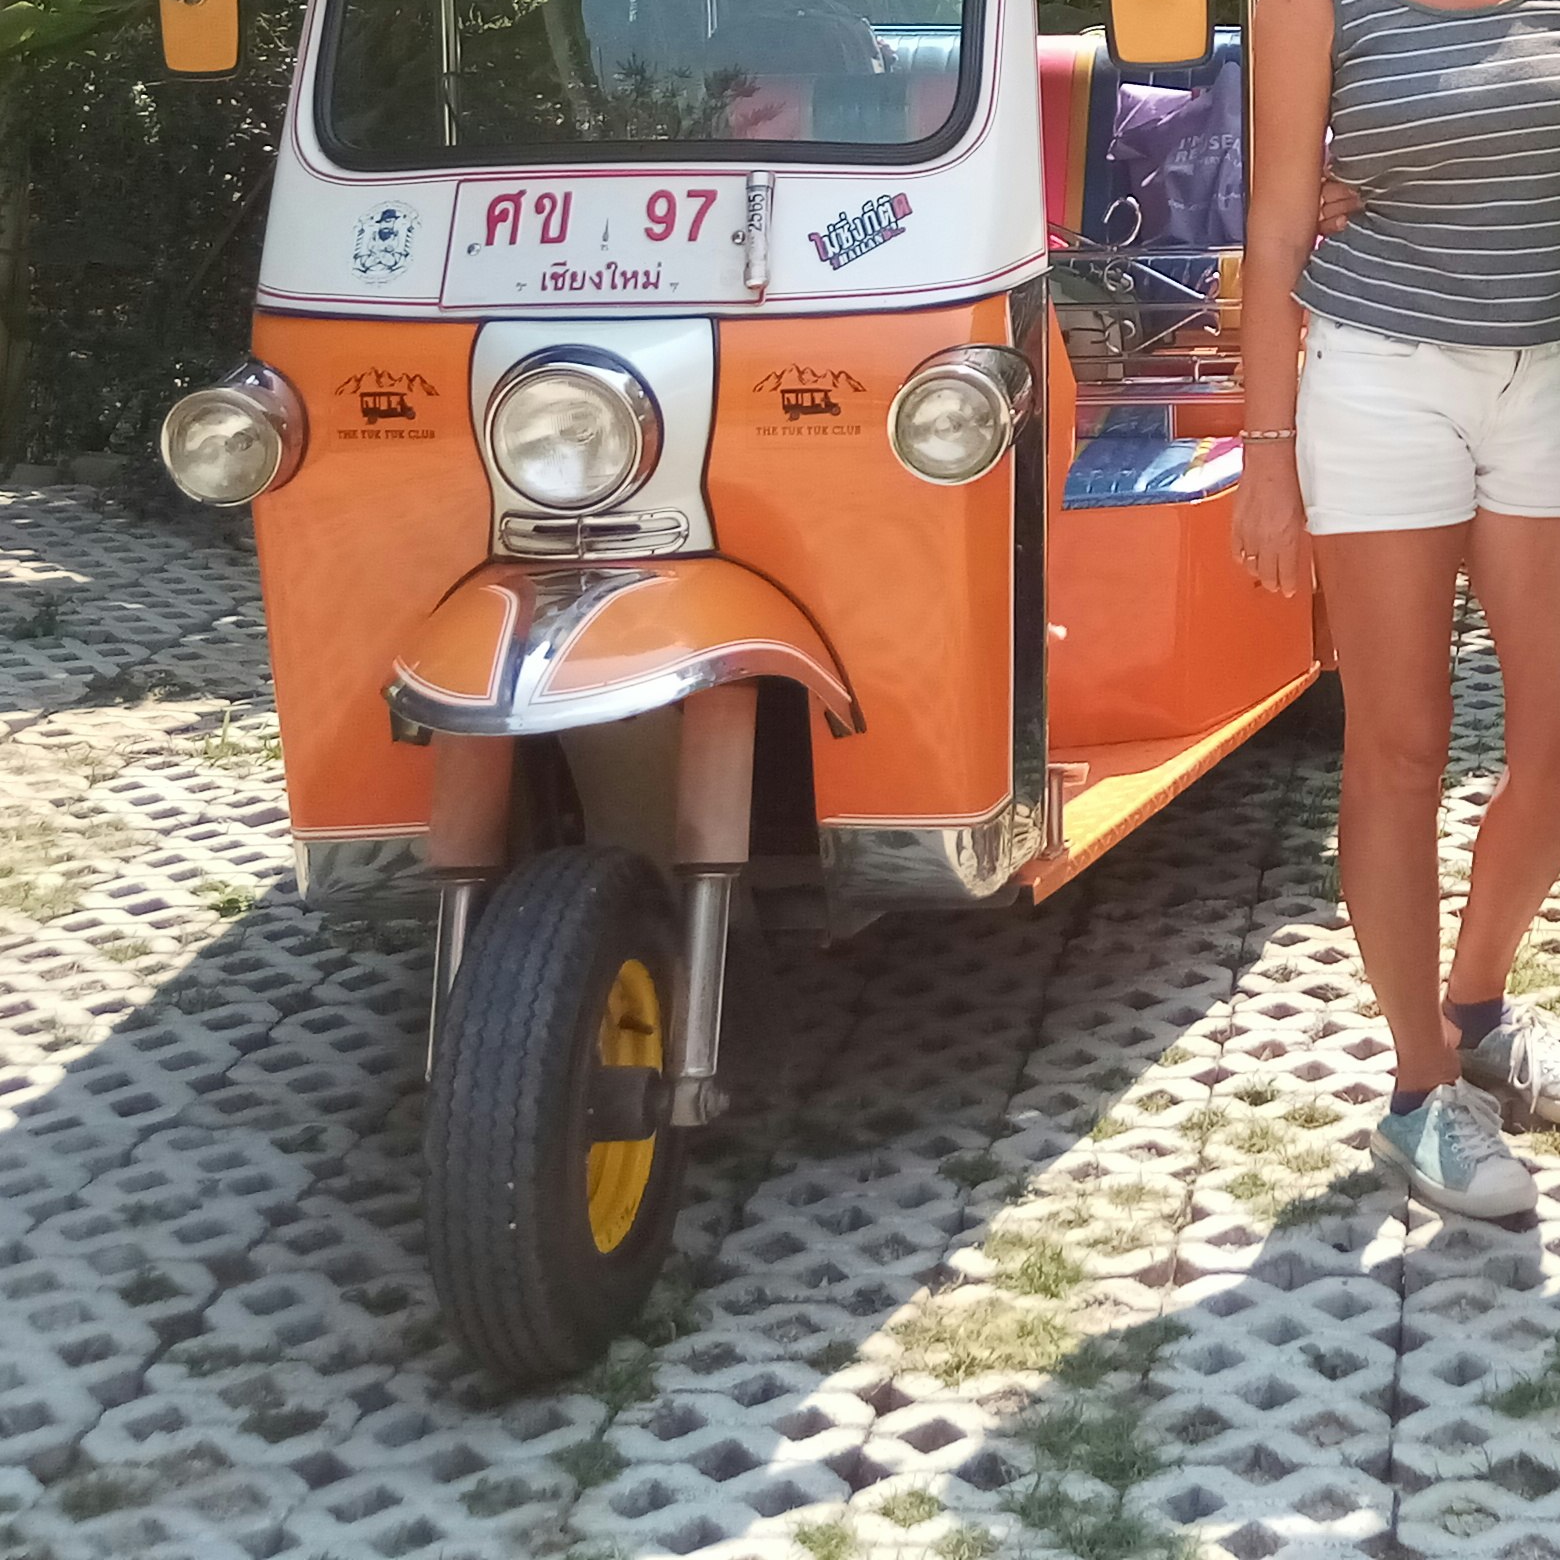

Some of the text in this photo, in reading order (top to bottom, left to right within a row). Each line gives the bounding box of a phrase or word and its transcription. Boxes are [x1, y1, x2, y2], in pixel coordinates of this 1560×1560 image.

[484, 189, 719, 246] ศข 97
[747, 193, 765, 233] 2565
[540, 260, 663, 292] เชียงใหม่
[337, 428, 436, 440] THE TUK TUK CLUB
[755, 424, 862, 436] THE TUK TUK CLUB
